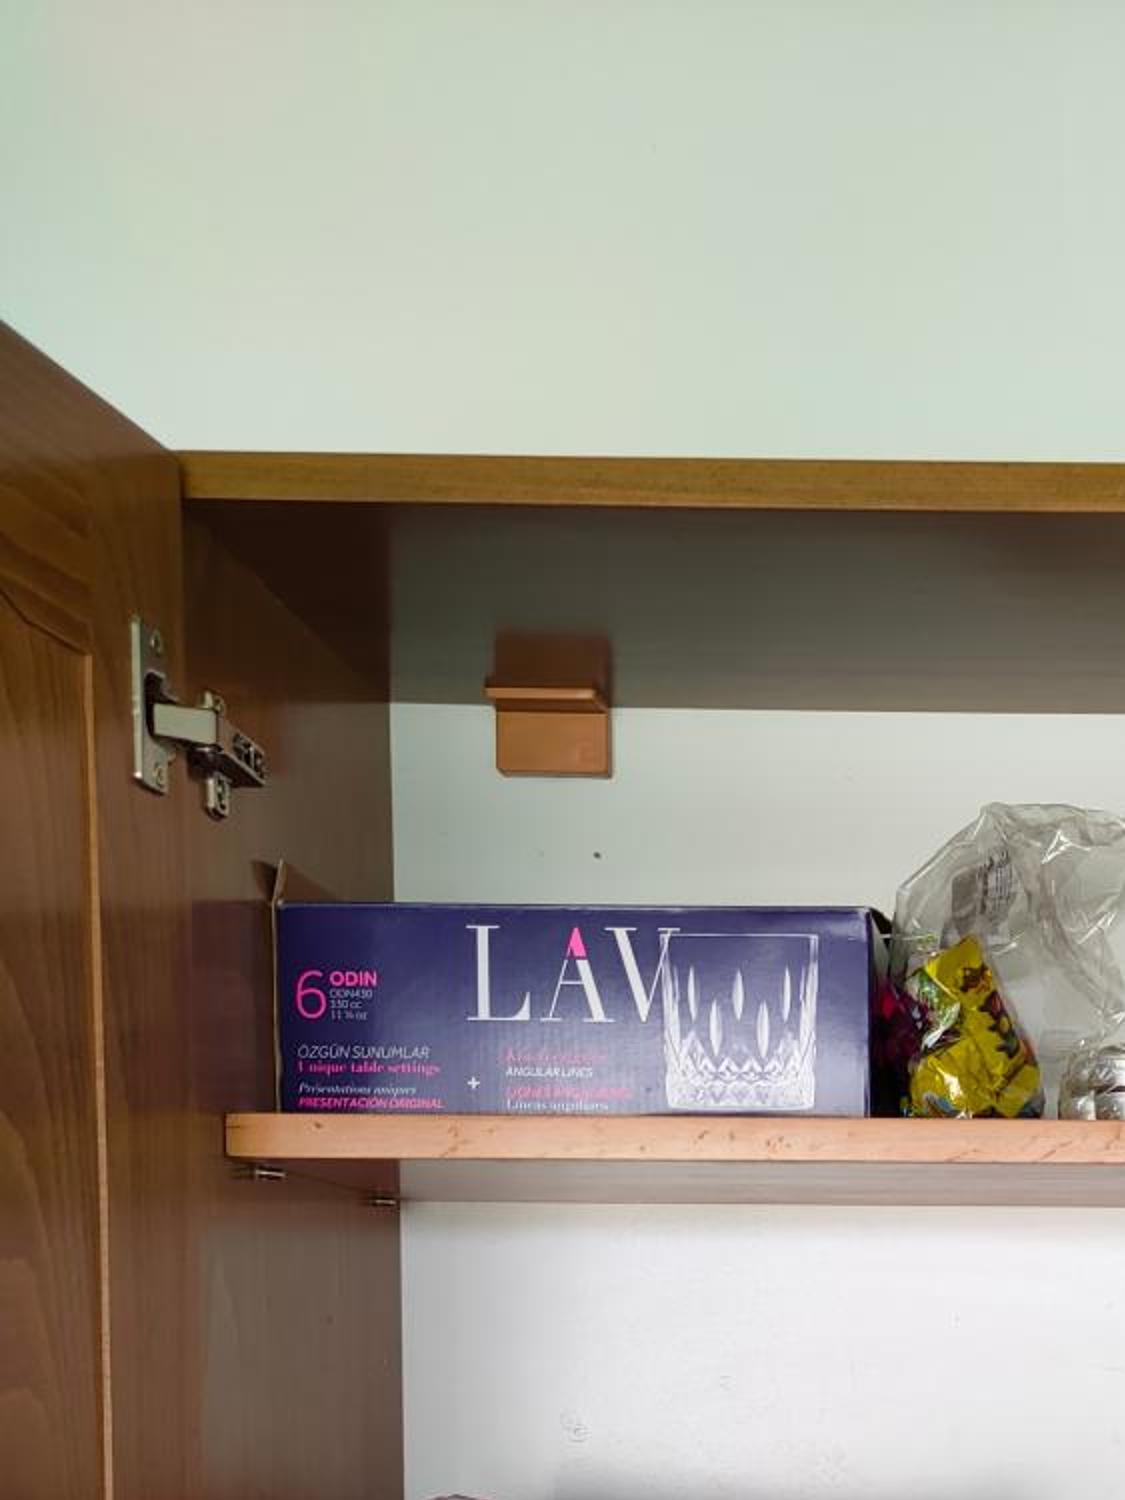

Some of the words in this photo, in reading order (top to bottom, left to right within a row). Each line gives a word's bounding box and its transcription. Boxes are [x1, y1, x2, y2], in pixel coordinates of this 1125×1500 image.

[329, 970, 378, 987] ODIN
[465, 924, 681, 1023] LAV
[296, 969, 327, 1019] 6
[351, 1044, 432, 1059] SUNUMLAR
[298, 1061, 347, 1076] Unique
[350, 1061, 385, 1073] table
[387, 1061, 441, 1077] settings
[389, 1097, 445, 1109] ORIGINAL
